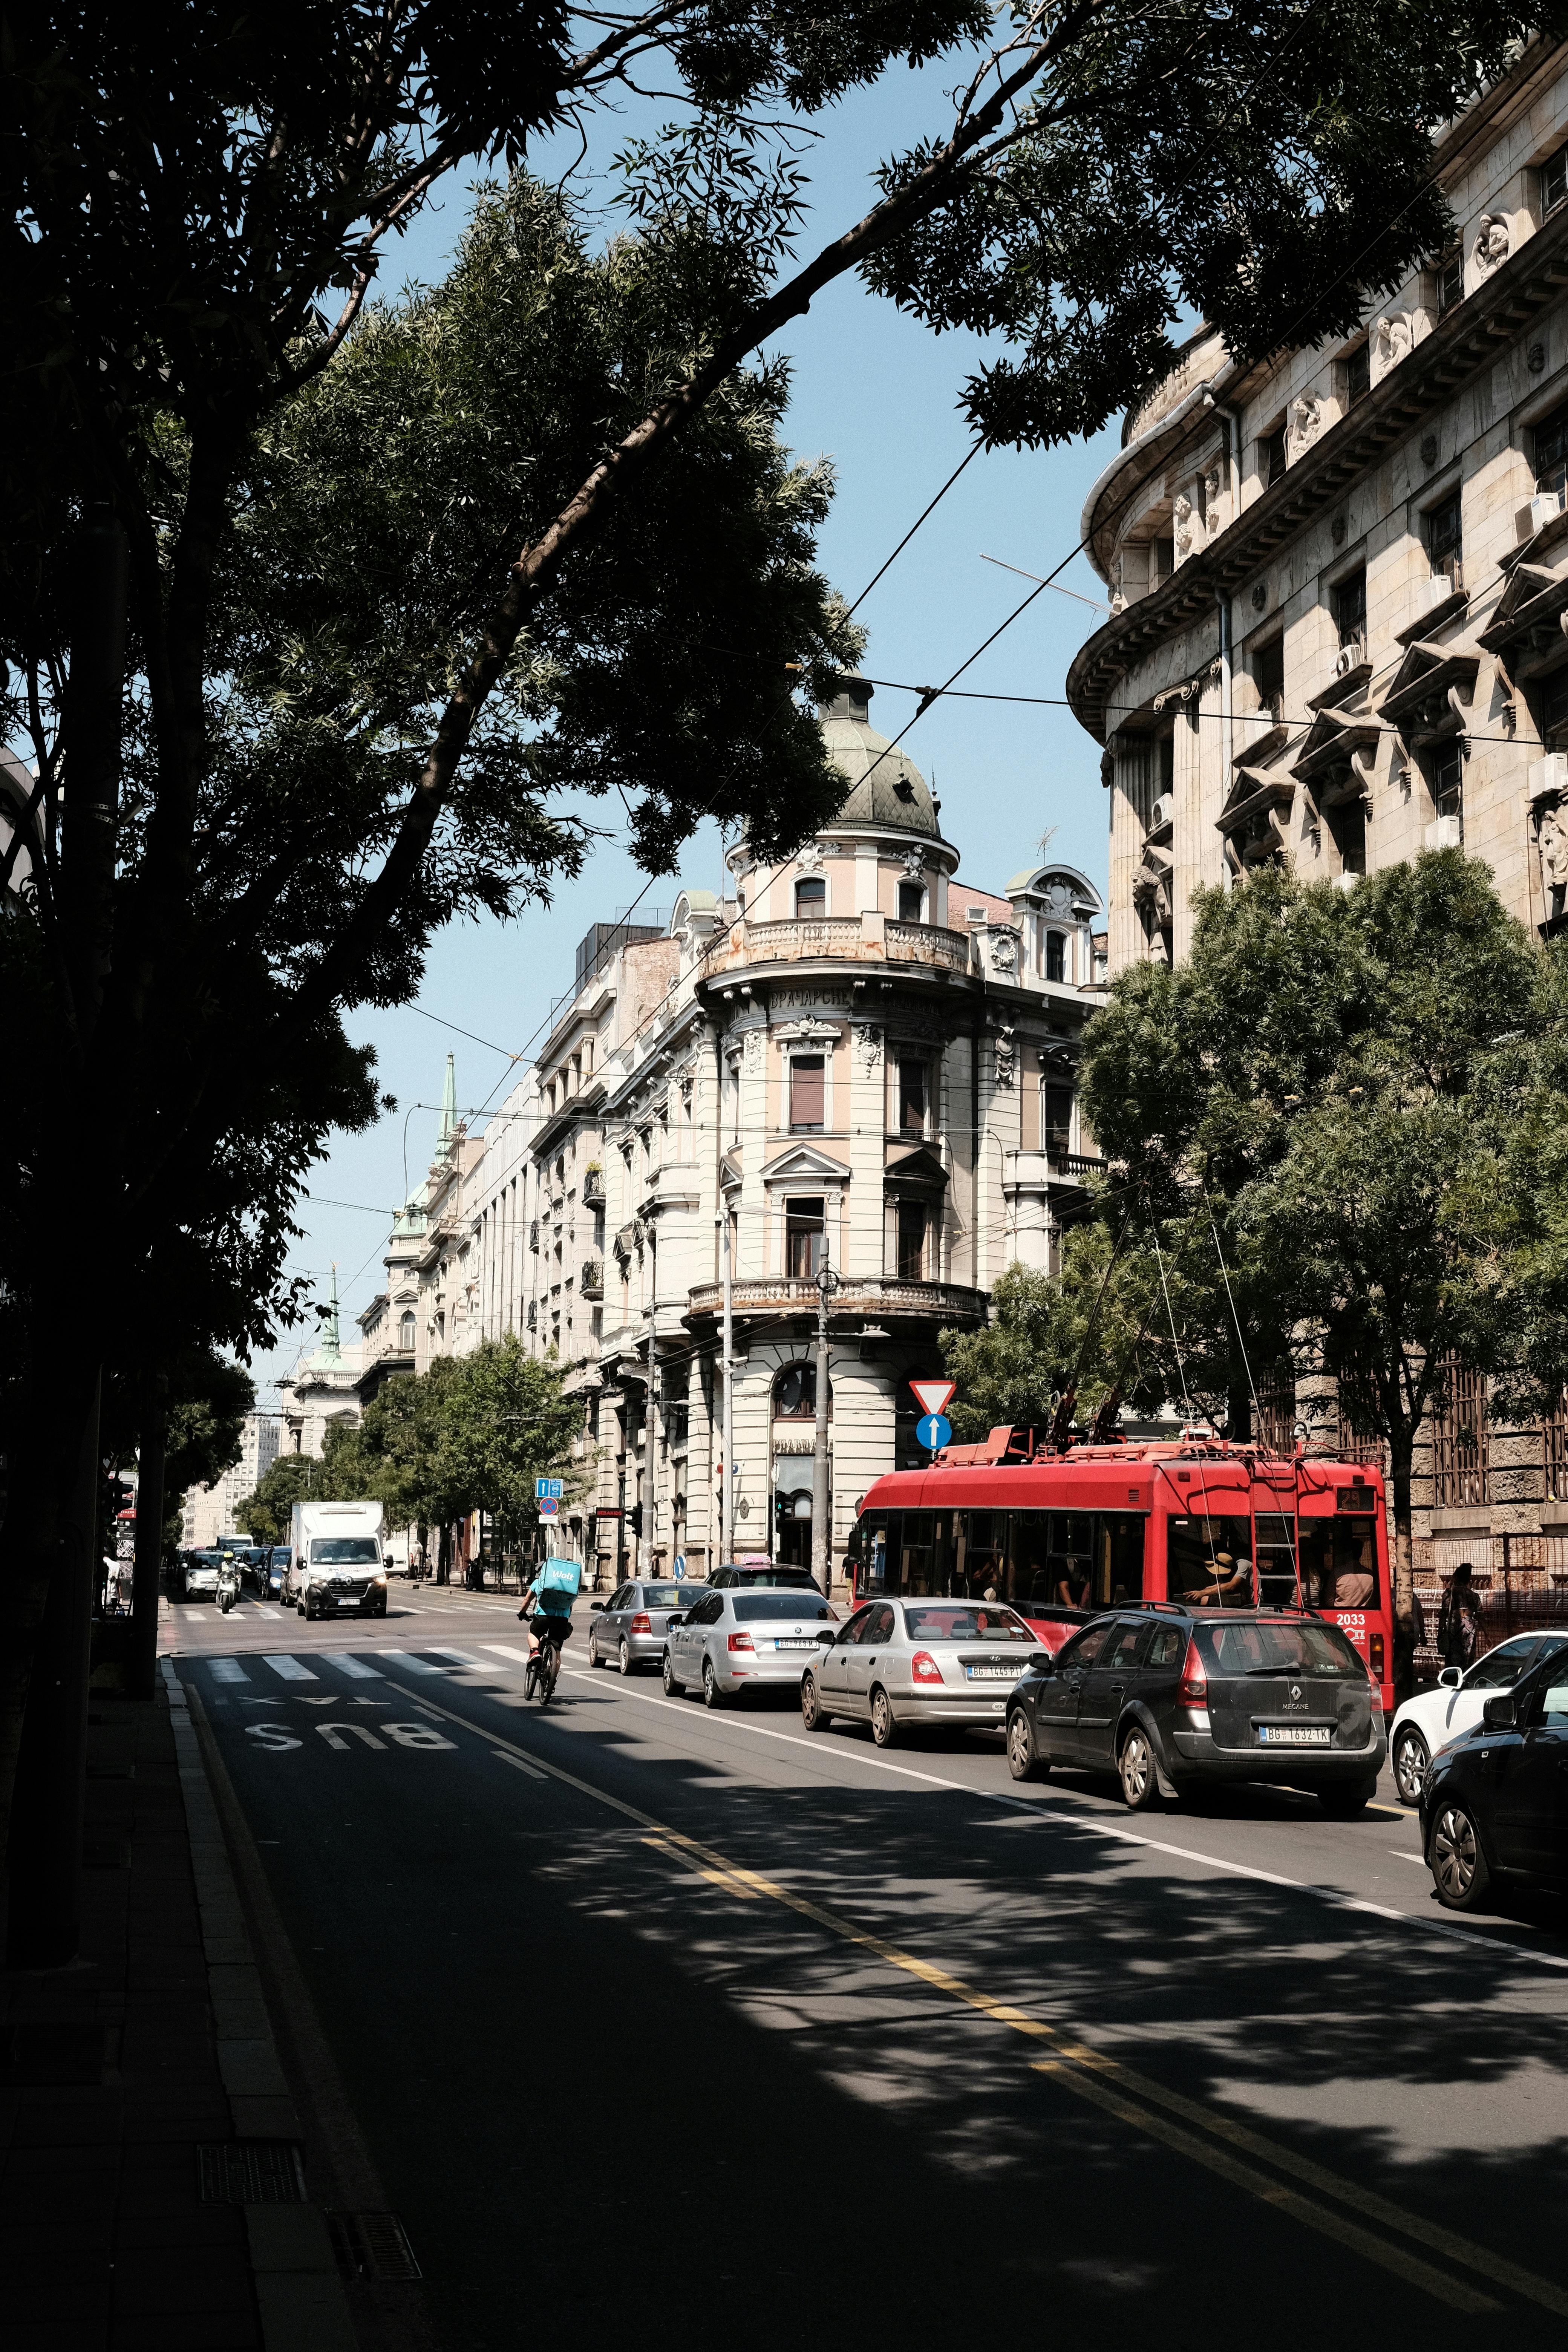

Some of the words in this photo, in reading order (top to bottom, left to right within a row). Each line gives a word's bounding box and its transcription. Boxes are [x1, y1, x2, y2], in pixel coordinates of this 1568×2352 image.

[773, 1439, 833, 1450] PHARMAE
[552, 1570, 574, 1581] Wolt
[1336, 1614, 1366, 1625] 2033
[974, 1667, 983, 1676] BG
[244, 1723, 459, 1751] BUS
[1268, 1728, 1280, 1740] BG
